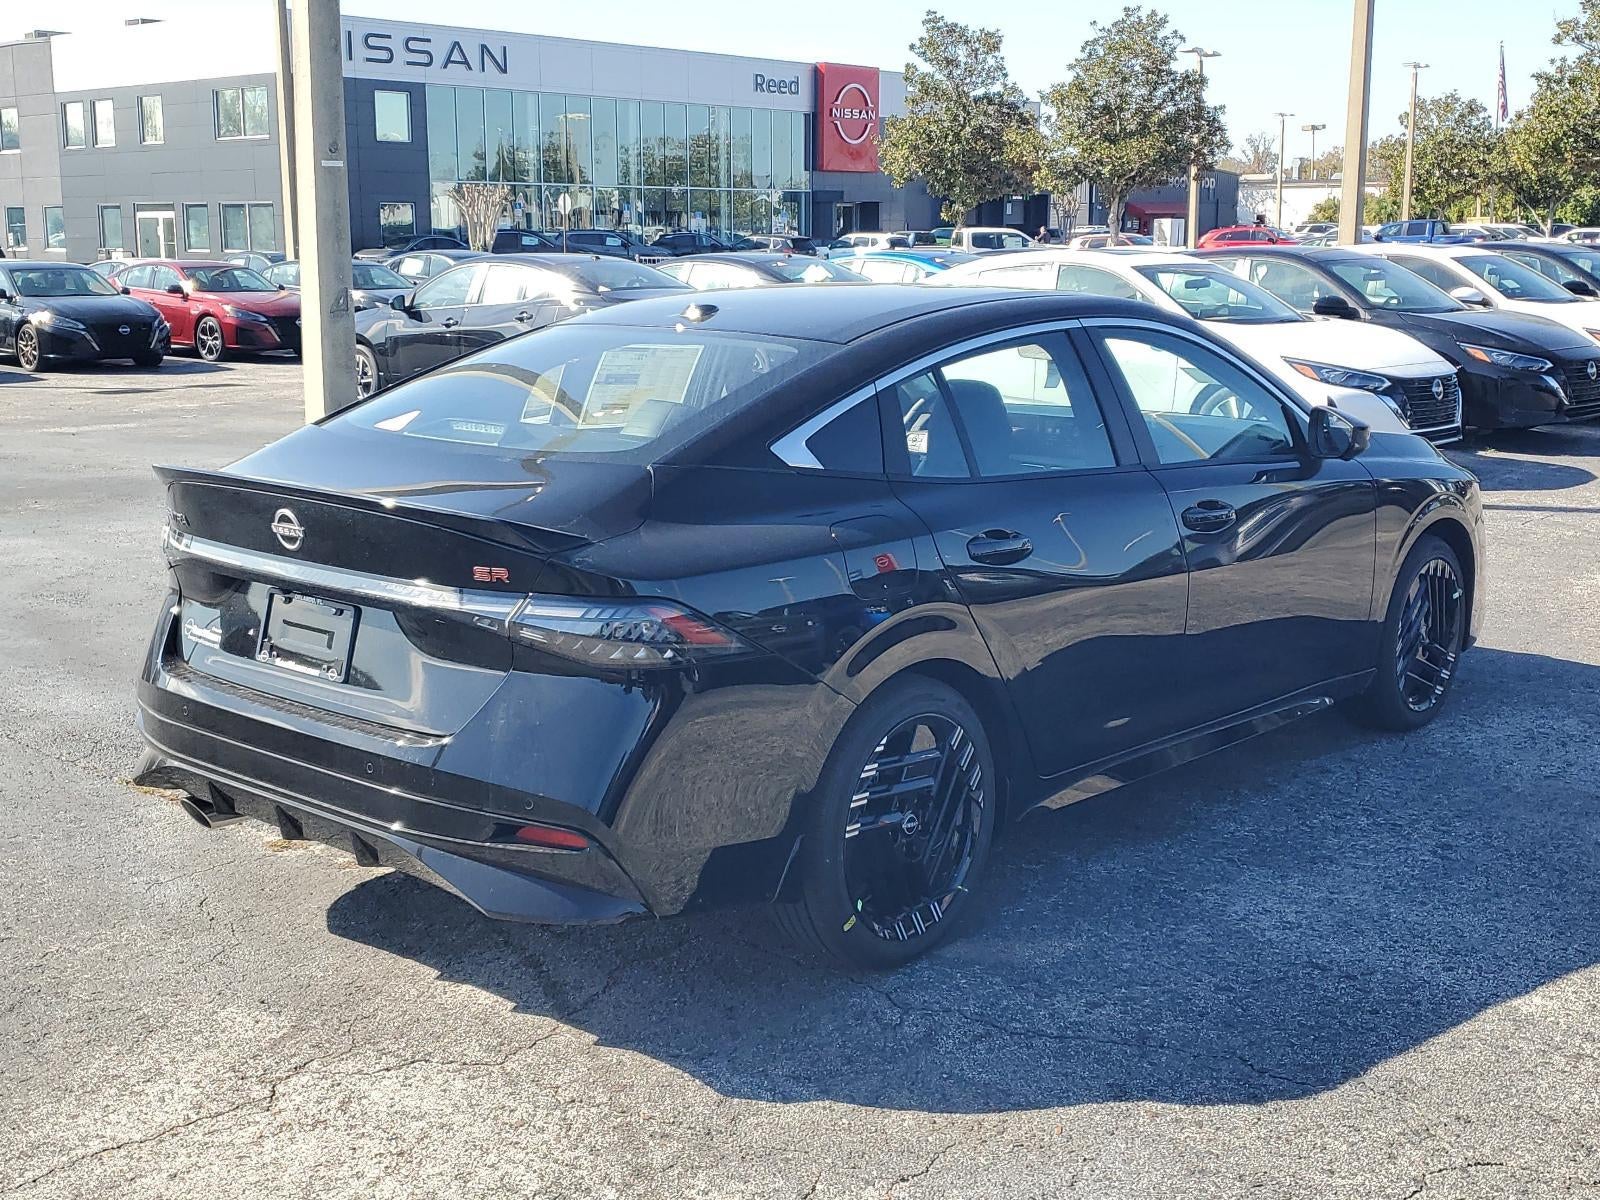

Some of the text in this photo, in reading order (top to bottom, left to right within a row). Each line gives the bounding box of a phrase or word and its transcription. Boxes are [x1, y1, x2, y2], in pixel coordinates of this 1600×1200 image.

[344, 29, 509, 75] ISSAN
[753, 73, 800, 96] Reed
[831, 106, 876, 120] NISSAN
[271, 524, 304, 538] NISSAN
[473, 566, 510, 583] SR
